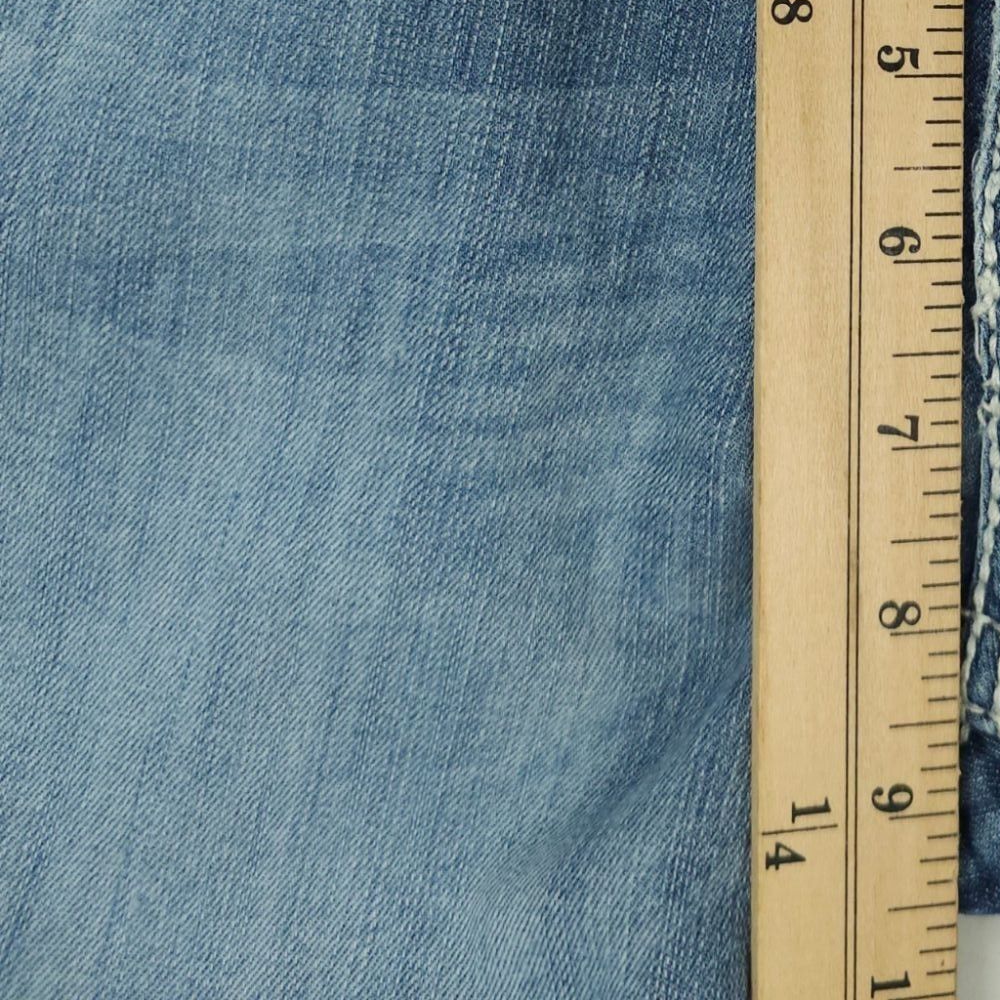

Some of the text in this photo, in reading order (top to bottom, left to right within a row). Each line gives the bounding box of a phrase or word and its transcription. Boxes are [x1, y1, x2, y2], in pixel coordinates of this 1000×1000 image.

[877, 44, 920, 73] 5
[878, 225, 921, 257] 6
[877, 413, 920, 442] 7
[878, 600, 921, 630] 8
[871, 783, 913, 813] 9
